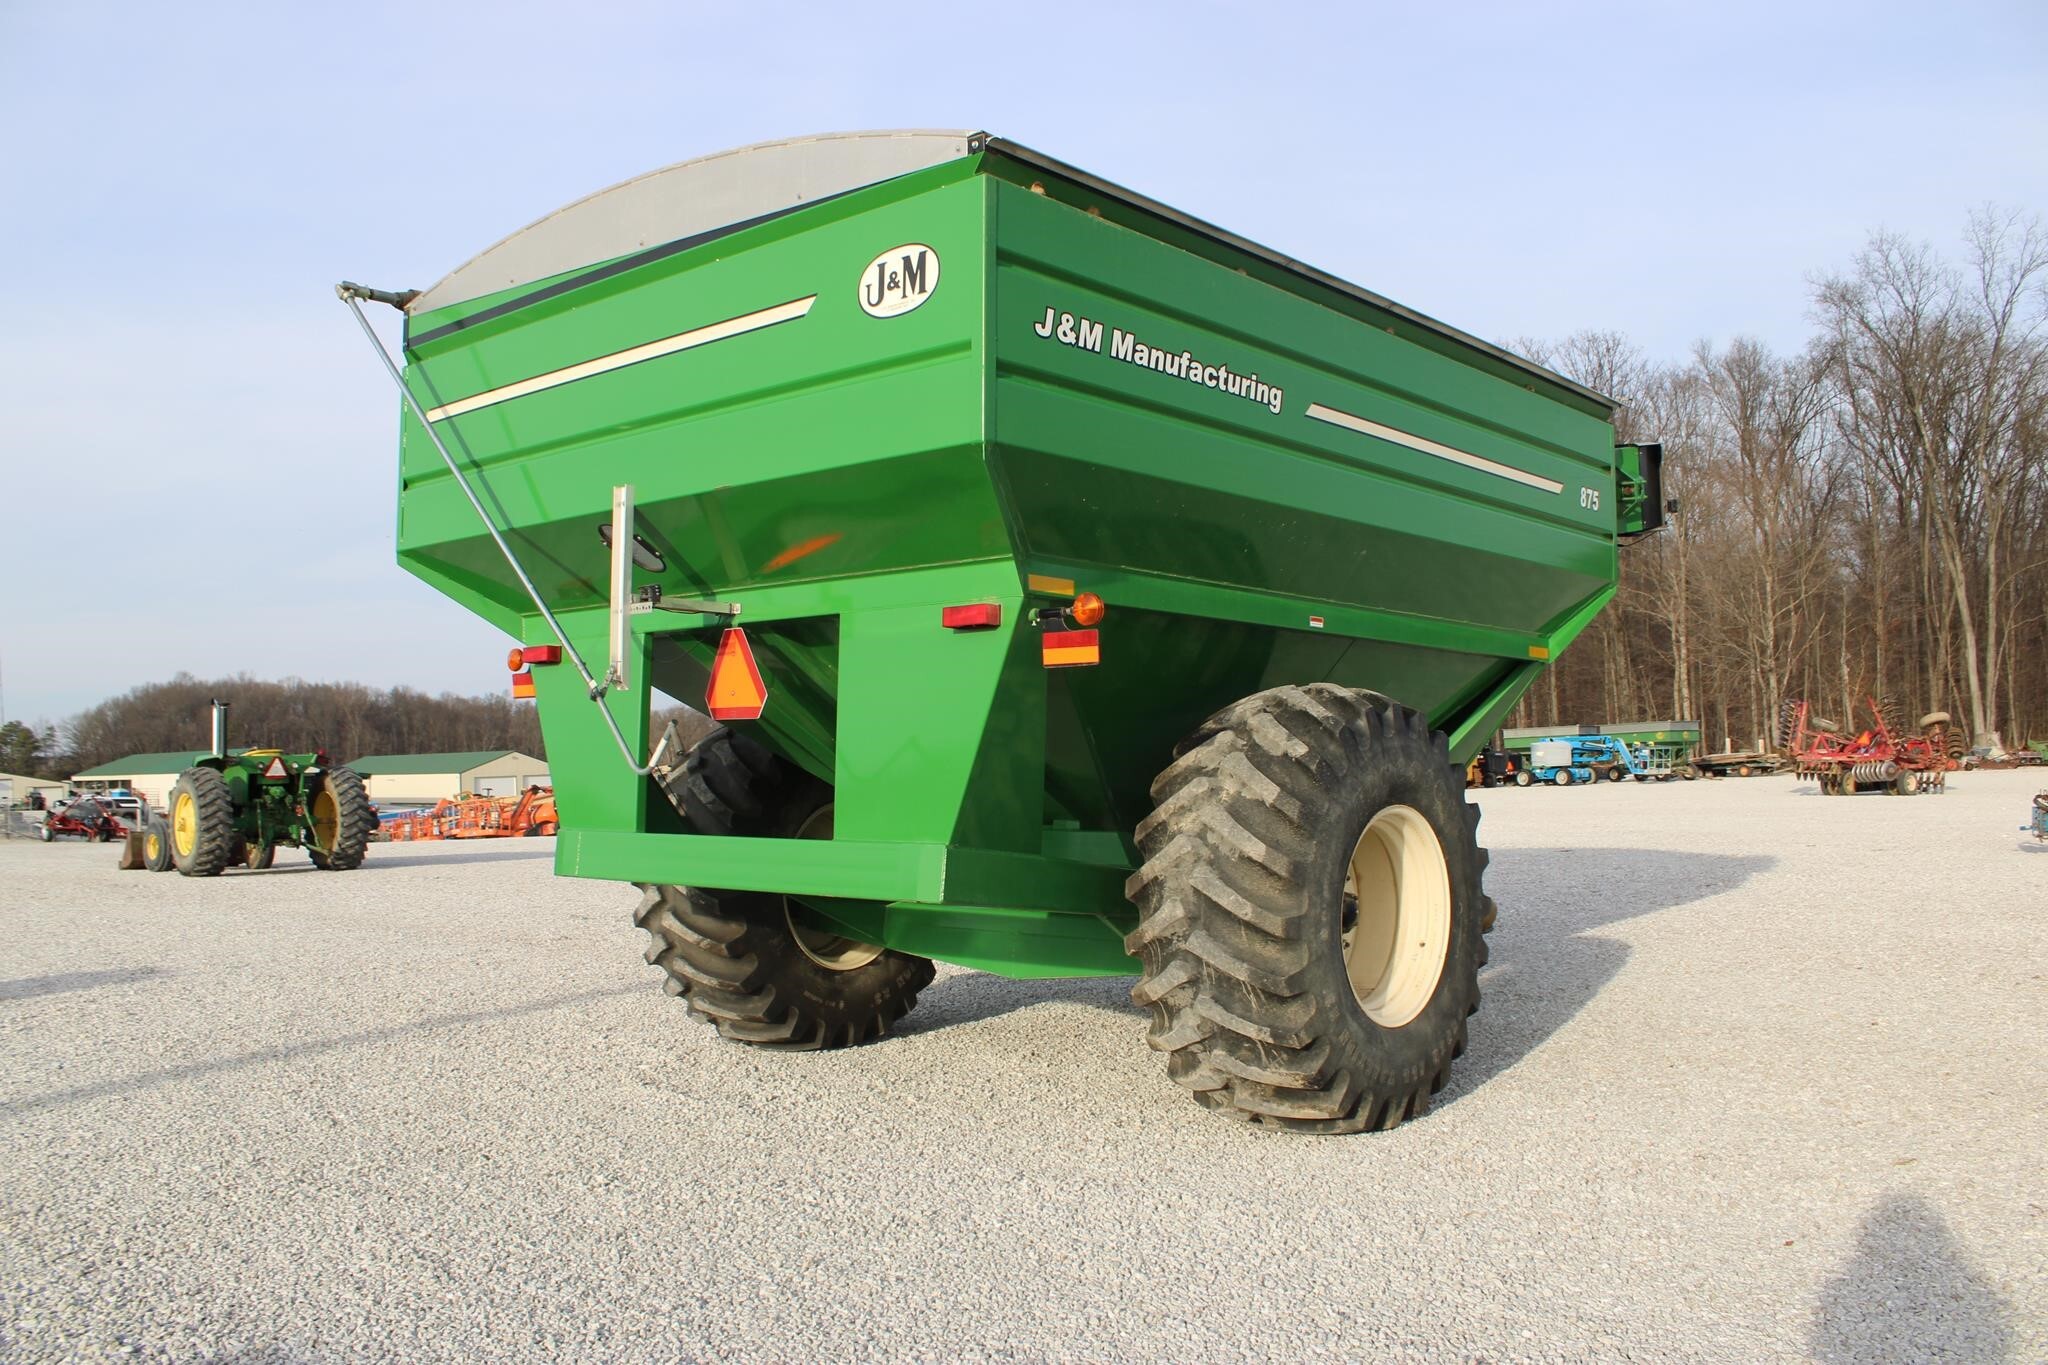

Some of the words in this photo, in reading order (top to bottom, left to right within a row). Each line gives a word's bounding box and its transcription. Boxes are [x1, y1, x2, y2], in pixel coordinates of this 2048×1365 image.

[865, 250, 928, 307] J&M
[1034, 306, 1104, 353] J&M
[1110, 327, 1283, 415] Manufacturing
[1580, 486, 1599, 511] 875
